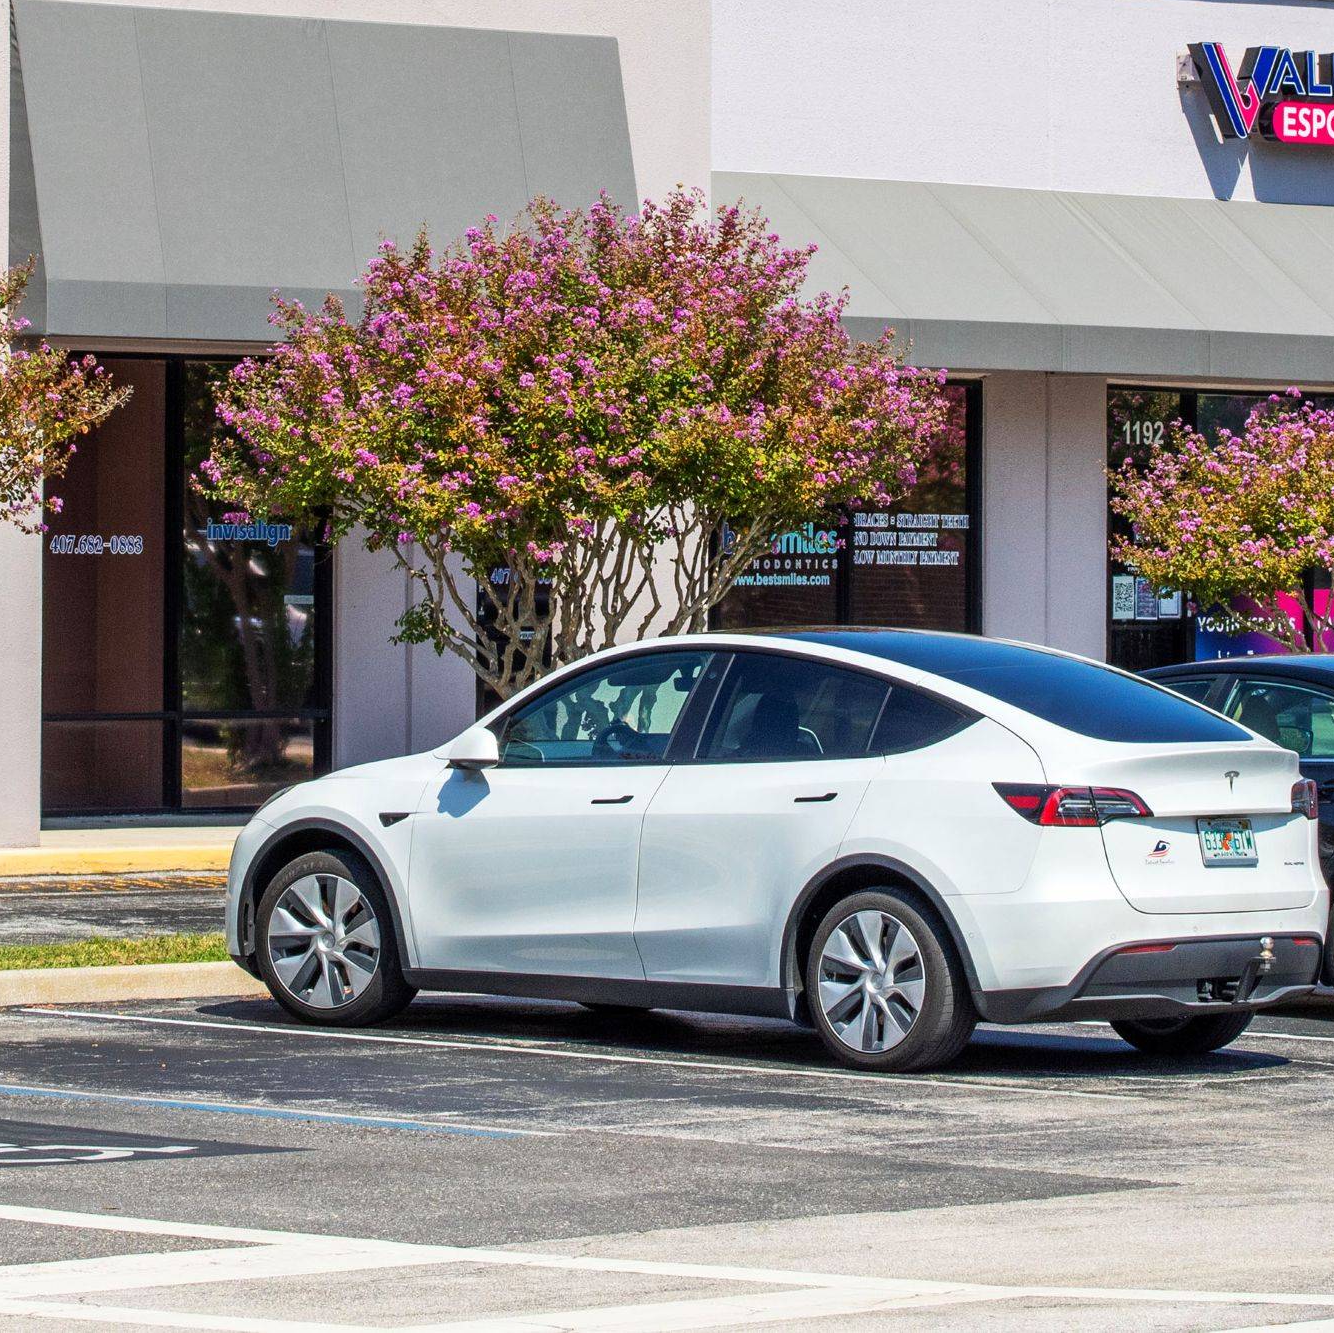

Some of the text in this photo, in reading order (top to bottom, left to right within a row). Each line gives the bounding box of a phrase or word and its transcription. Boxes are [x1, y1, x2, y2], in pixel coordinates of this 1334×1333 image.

[1122, 420, 1165, 445] 1192
[49, 534, 143, 555] 407.682-0883
[869, 531, 897, 546] DOWN
[898, 532, 938, 547] PAYMENT
[919, 551, 959, 566] PAYMENT
